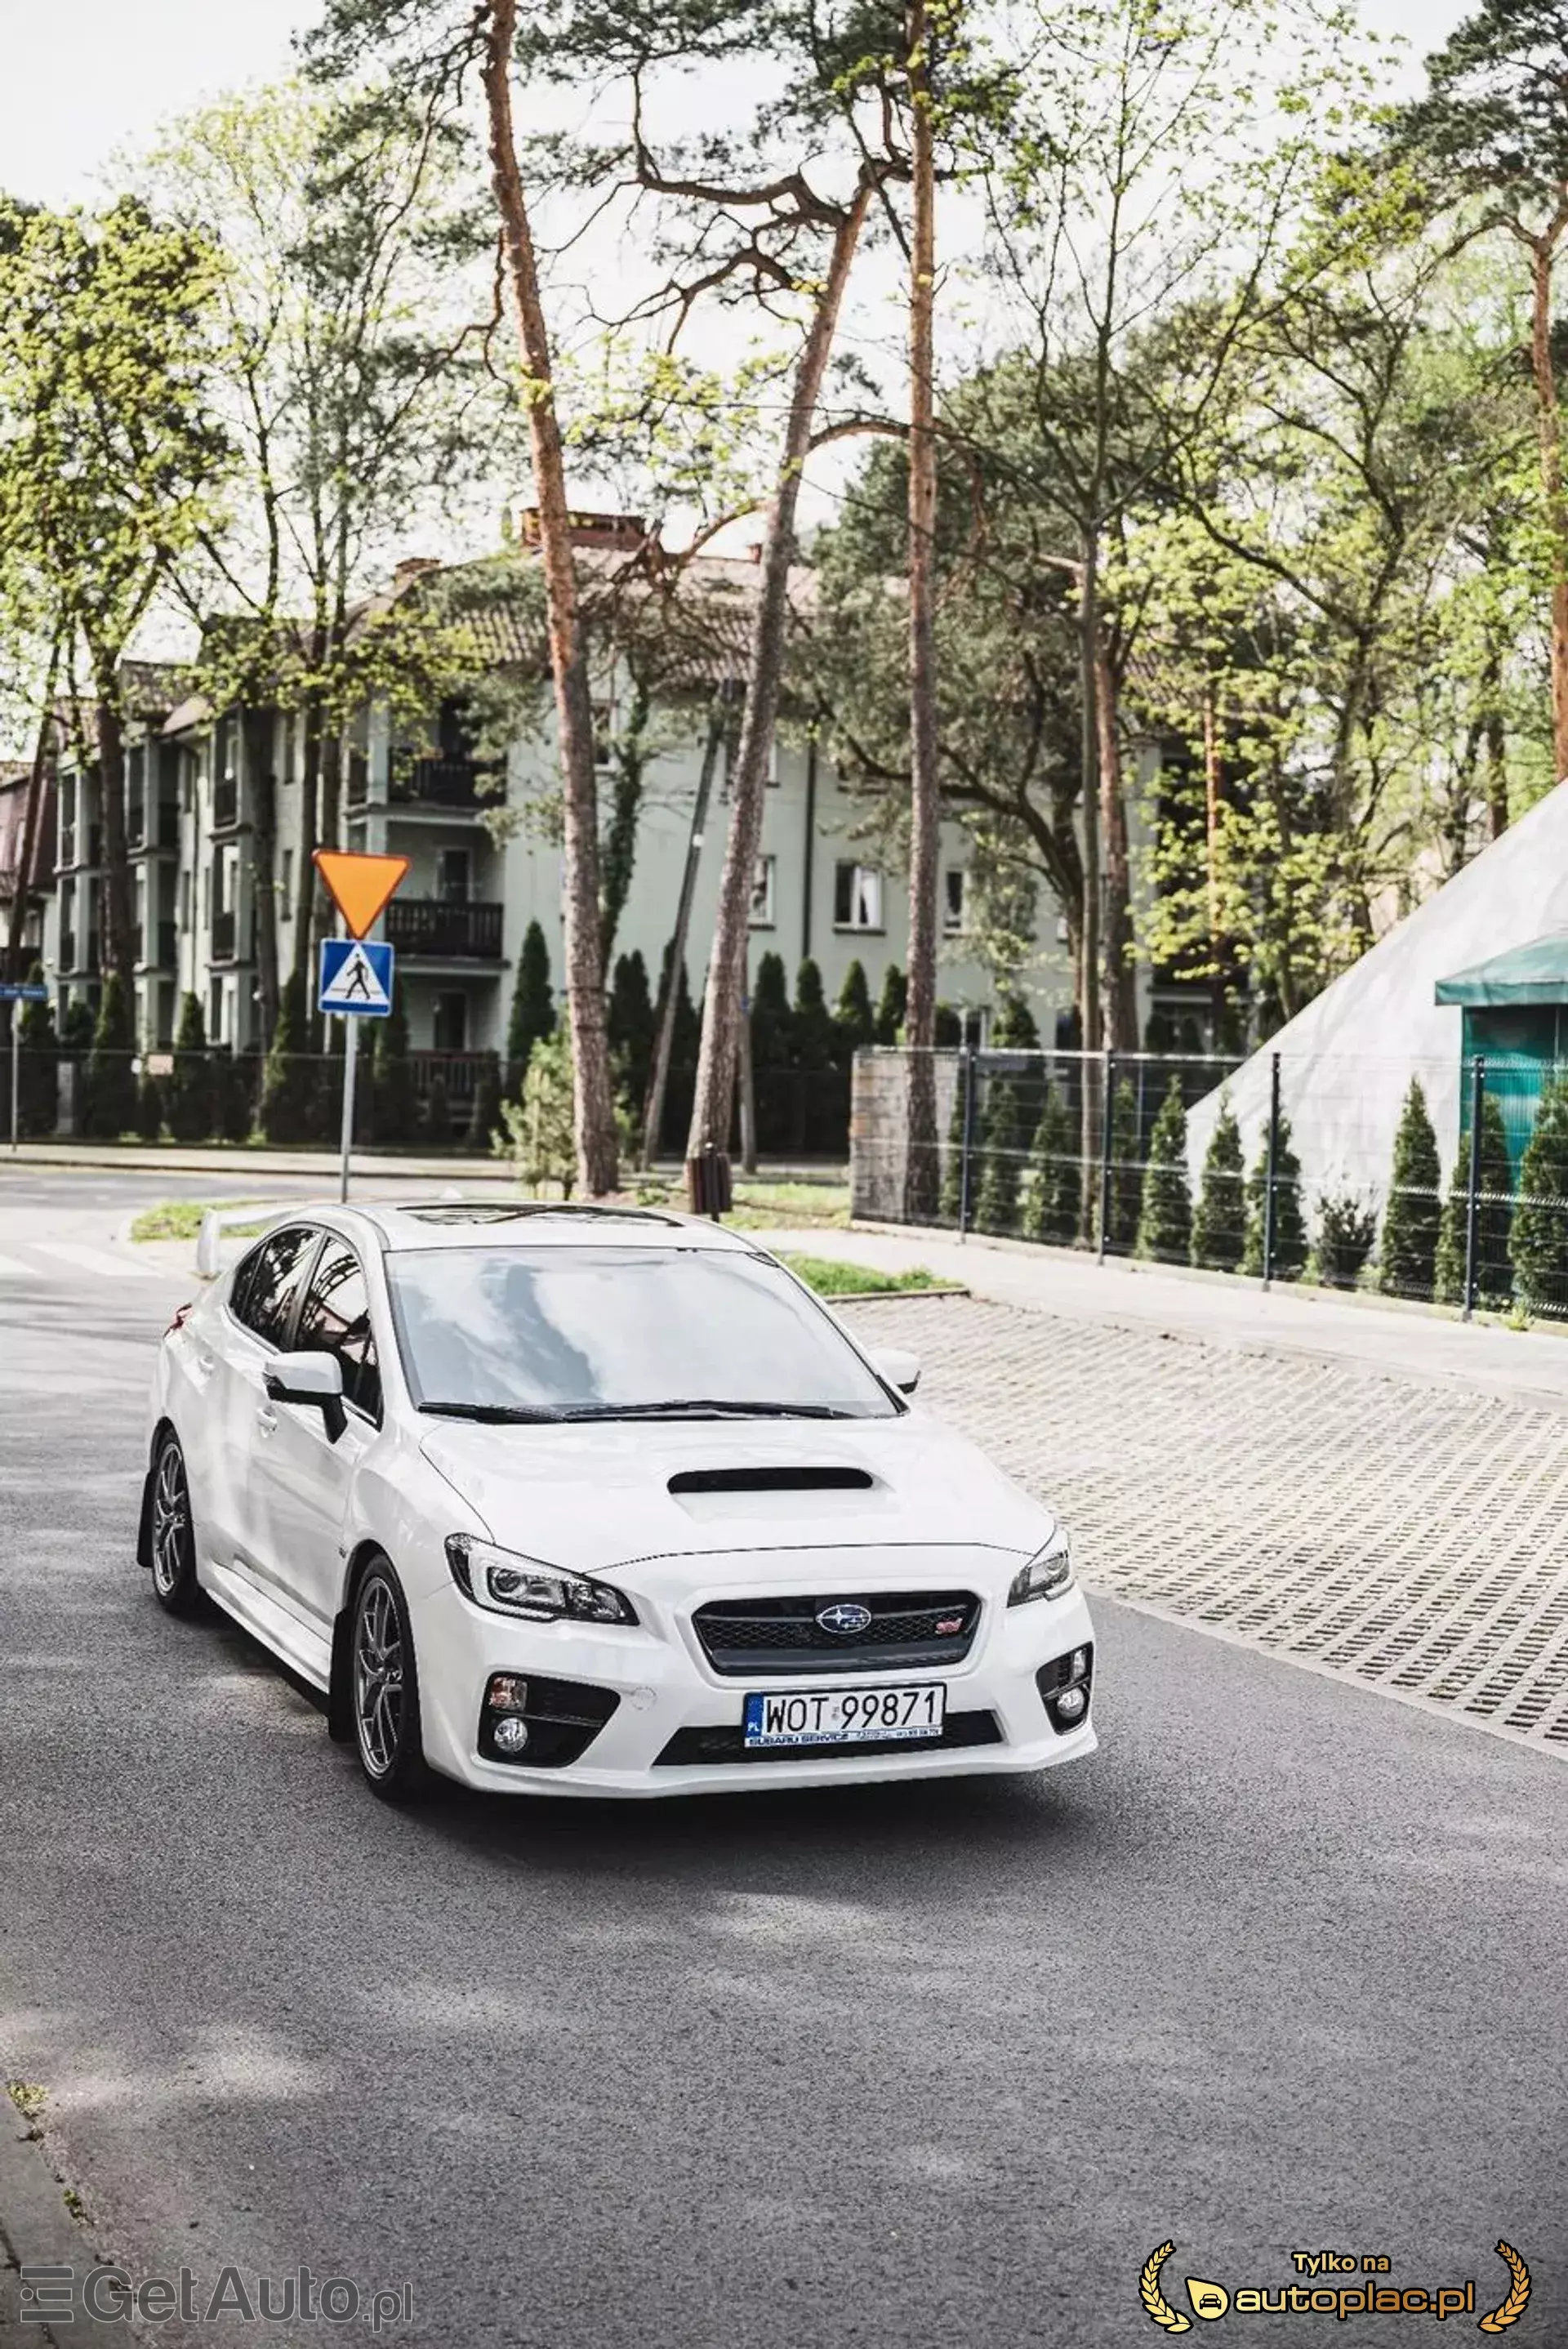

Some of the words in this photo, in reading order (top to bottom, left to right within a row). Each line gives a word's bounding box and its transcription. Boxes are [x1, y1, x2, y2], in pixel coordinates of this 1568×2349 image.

[766, 1697, 829, 1733] WOT
[841, 1691, 935, 1730] 99871
[748, 1722, 760, 1732] PL
